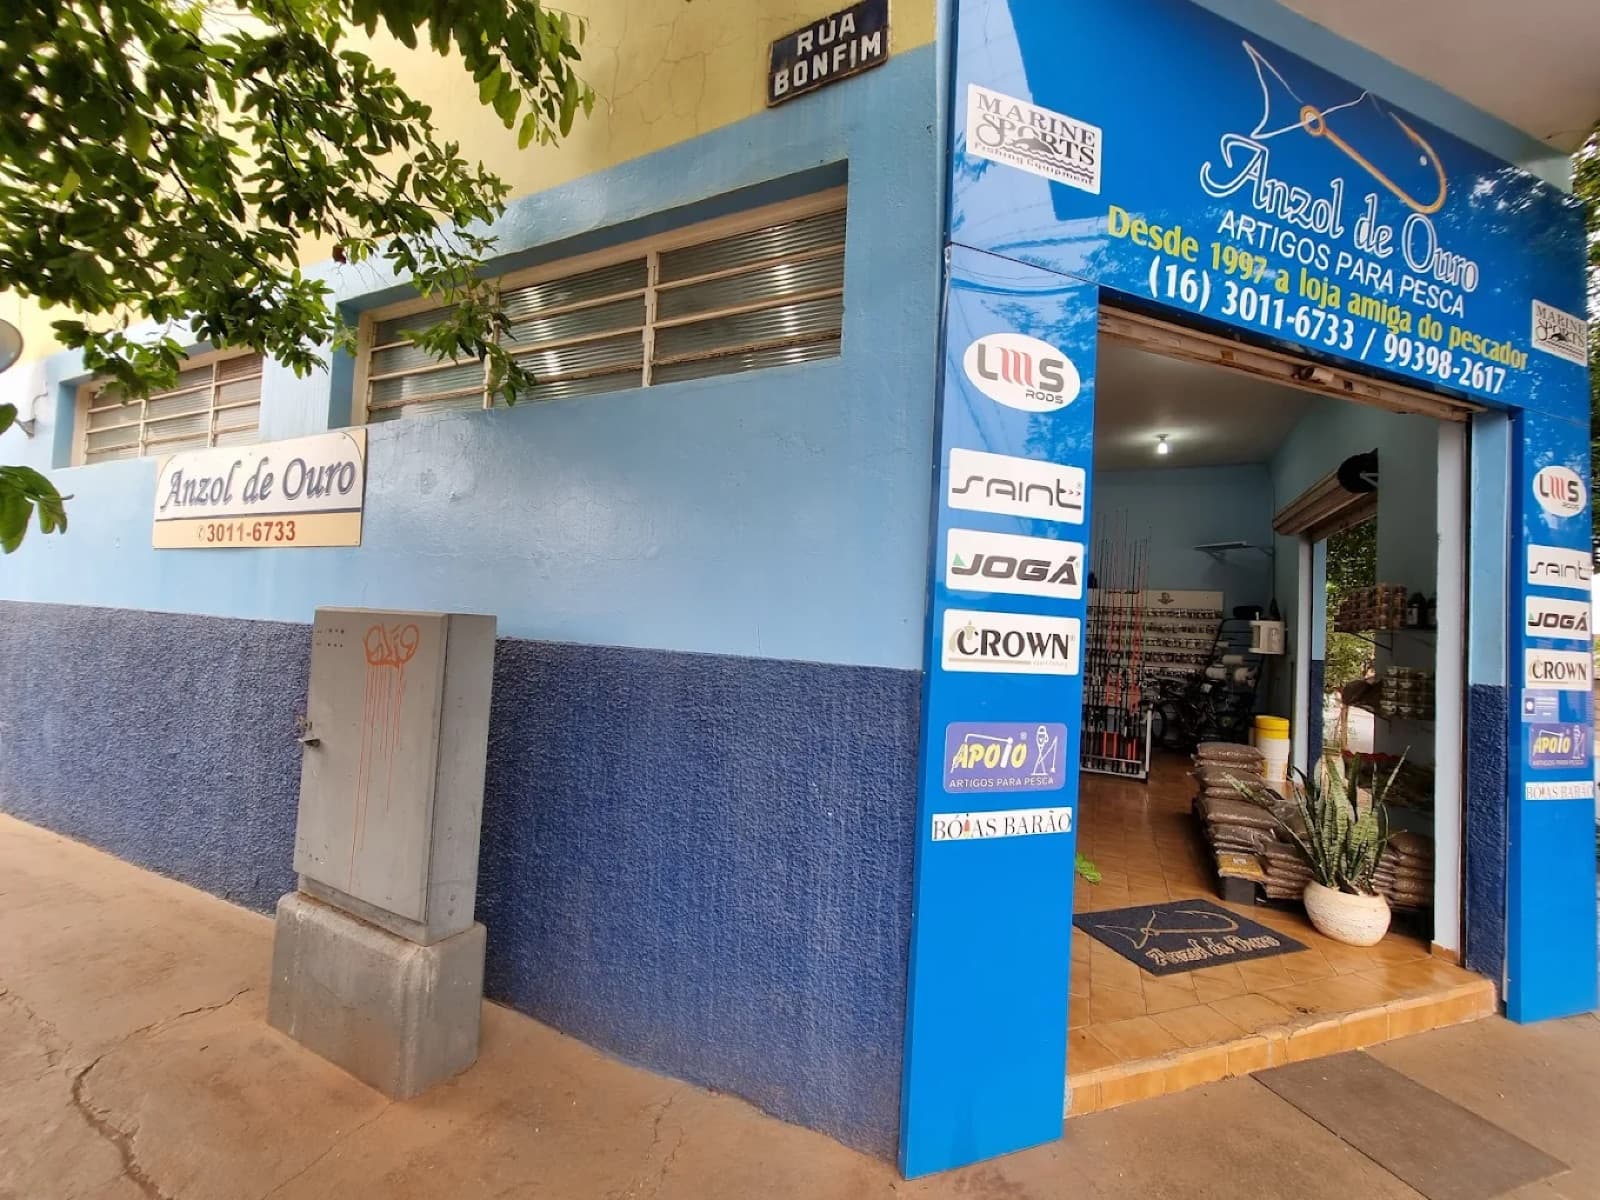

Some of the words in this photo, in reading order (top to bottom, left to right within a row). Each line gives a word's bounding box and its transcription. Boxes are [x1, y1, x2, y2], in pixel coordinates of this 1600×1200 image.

[797, 12, 856, 56] RUA
[774, 31, 881, 97] BONFIM
[976, 92, 1096, 148] MARINE
[976, 113, 1095, 166] SPORTS
[1200, 133, 1345, 239] Anzol
[1354, 192, 1394, 258] de
[1402, 213, 1480, 293] Ouro
[1217, 209, 1331, 271] ARTIGOS
[1335, 251, 1394, 295] PARA
[1400, 275, 1465, 319] PESCA
[1108, 205, 1199, 263] Desde
[1211, 242, 1268, 284] 1997
[1275, 269, 1290, 294] a
[1300, 267, 1341, 310] loja
[1347, 292, 1411, 335] amiga
[1417, 313, 1443, 341] do
[1448, 325, 1529, 371] pescador
[1148, 255, 1211, 313] (16)
[1221, 280, 1354, 351] 3011-6733
[1359, 328, 1377, 361] /
[1383, 334, 1507, 394] 99398-2617
[1025, 389, 1064, 405] RODS
[160, 459, 242, 512] Anzol
[242, 456, 275, 504] de
[282, 458, 356, 501] Ouro
[206, 520, 296, 543] 3011-6733
[951, 553, 1078, 586] JOGÁ
[1528, 611, 1588, 632] JOGÁ
[957, 629, 1069, 660] CROWN
[1532, 660, 1587, 681] CROWN
[952, 737, 1028, 771] APOIO
[949, 777, 994, 789] ARTIGOS
[996, 777, 1021, 788] PARA
[1024, 776, 1054, 786] PESCA
[1005, 810, 1071, 835] BARÃO
